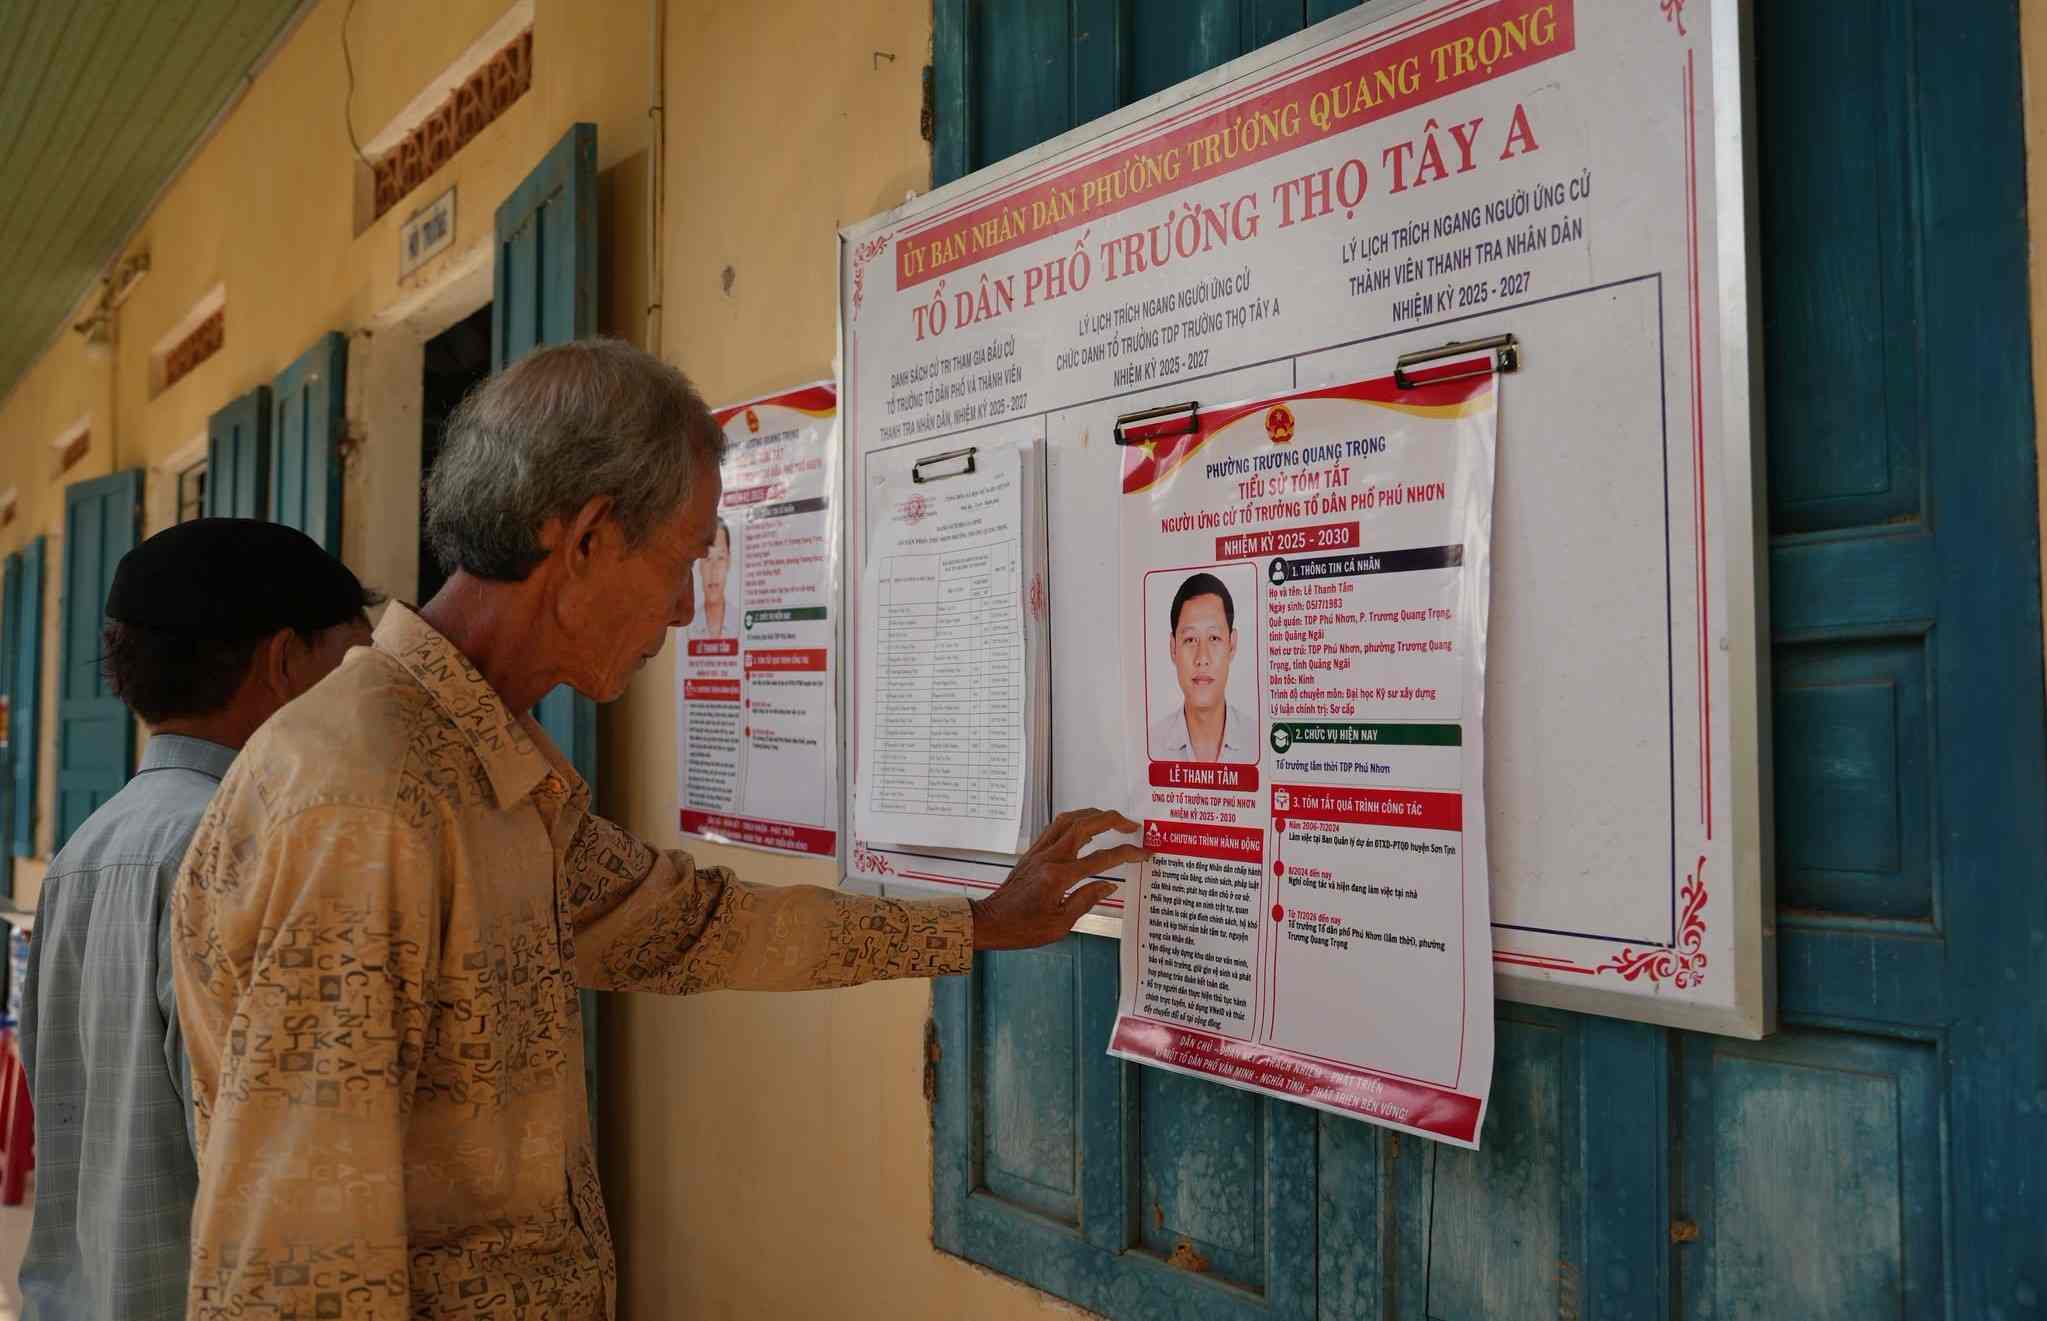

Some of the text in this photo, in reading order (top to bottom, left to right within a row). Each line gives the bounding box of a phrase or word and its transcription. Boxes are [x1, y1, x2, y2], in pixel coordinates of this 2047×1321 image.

[903, 4, 1556, 277] ỦY BAN NHÂN DÂN PHƯỜNG TRƯƠNG QUANG TRỌNG
[912, 103, 1539, 341] TỔ DÂN PHỐ TRƯỜNG THỌ TÂY A
[1342, 170, 1591, 264] LÝ LỊCH TRÍCH NGANG NGƯỜI ỨNG CỬ
[1348, 215, 1582, 296] THÀNH VIÊN THANH TRA NHÂN DÂN
[1079, 265, 1250, 336] LÝ LỊCH TRÍCH NGANG NGƯỜI ỨNG CỬ
[1392, 291, 1432, 322] NHIỆM
[1436, 283, 1454, 312] KỲ
[1458, 280, 1488, 307] 2025
[1499, 270, 1530, 297] 2027
[1056, 297, 1280, 371] CHỨC DANH TỔ TRƯỞNG TDP TRƯỜNG THỌ TÂY A
[1113, 361, 1142, 387] NHIỆM
[1144, 356, 1156, 380] KỲ
[1159, 355, 1180, 376] 2025
[1187, 348, 1208, 370] 2027
[1205, 435, 1385, 479] PHƯỜNG TRƯƠNG QUANG TRỌNG
[1237, 463, 1350, 500] TIỂU SỬ TÓM TẮT
[1161, 482, 1444, 533] NGƯỜI ỨNG CỬ TỔ TRƯỞNG TỔ DÂN PHỐ PHÚ NHƠN
[1224, 537, 1257, 557] NHIỆM
[1260, 535, 1274, 551] KỲ
[1277, 531, 1305, 549] 2025
[1317, 527, 1349, 545] 2030
[1299, 560, 1326, 576] THÔNG
[1327, 561, 1342, 573] TIN
[1343, 557, 1355, 572] CÁ
[1356, 555, 1380, 571] NHÂN
[1304, 728, 1325, 740] CHỨC
[1326, 728, 1337, 743] VỤ
[1339, 725, 1359, 743] HIỆN
[1360, 728, 1378, 740] NAY
[1169, 764, 1238, 785] LÊ THANH TÂM
[1301, 796, 1318, 808] TÓM
[1320, 795, 1334, 809] TẮT
[1336, 796, 1352, 812] QUÁ
[1354, 797, 1379, 812] TRÌNH
[1381, 798, 1404, 814] CÔNG
[1405, 800, 1422, 816] TÁC
[1169, 832, 1197, 844] CHƯƠNG
[1198, 832, 1218, 847] TRÌNH
[1219, 834, 1239, 848] HÀNH
[1240, 836, 1260, 851] ĐỘNG
